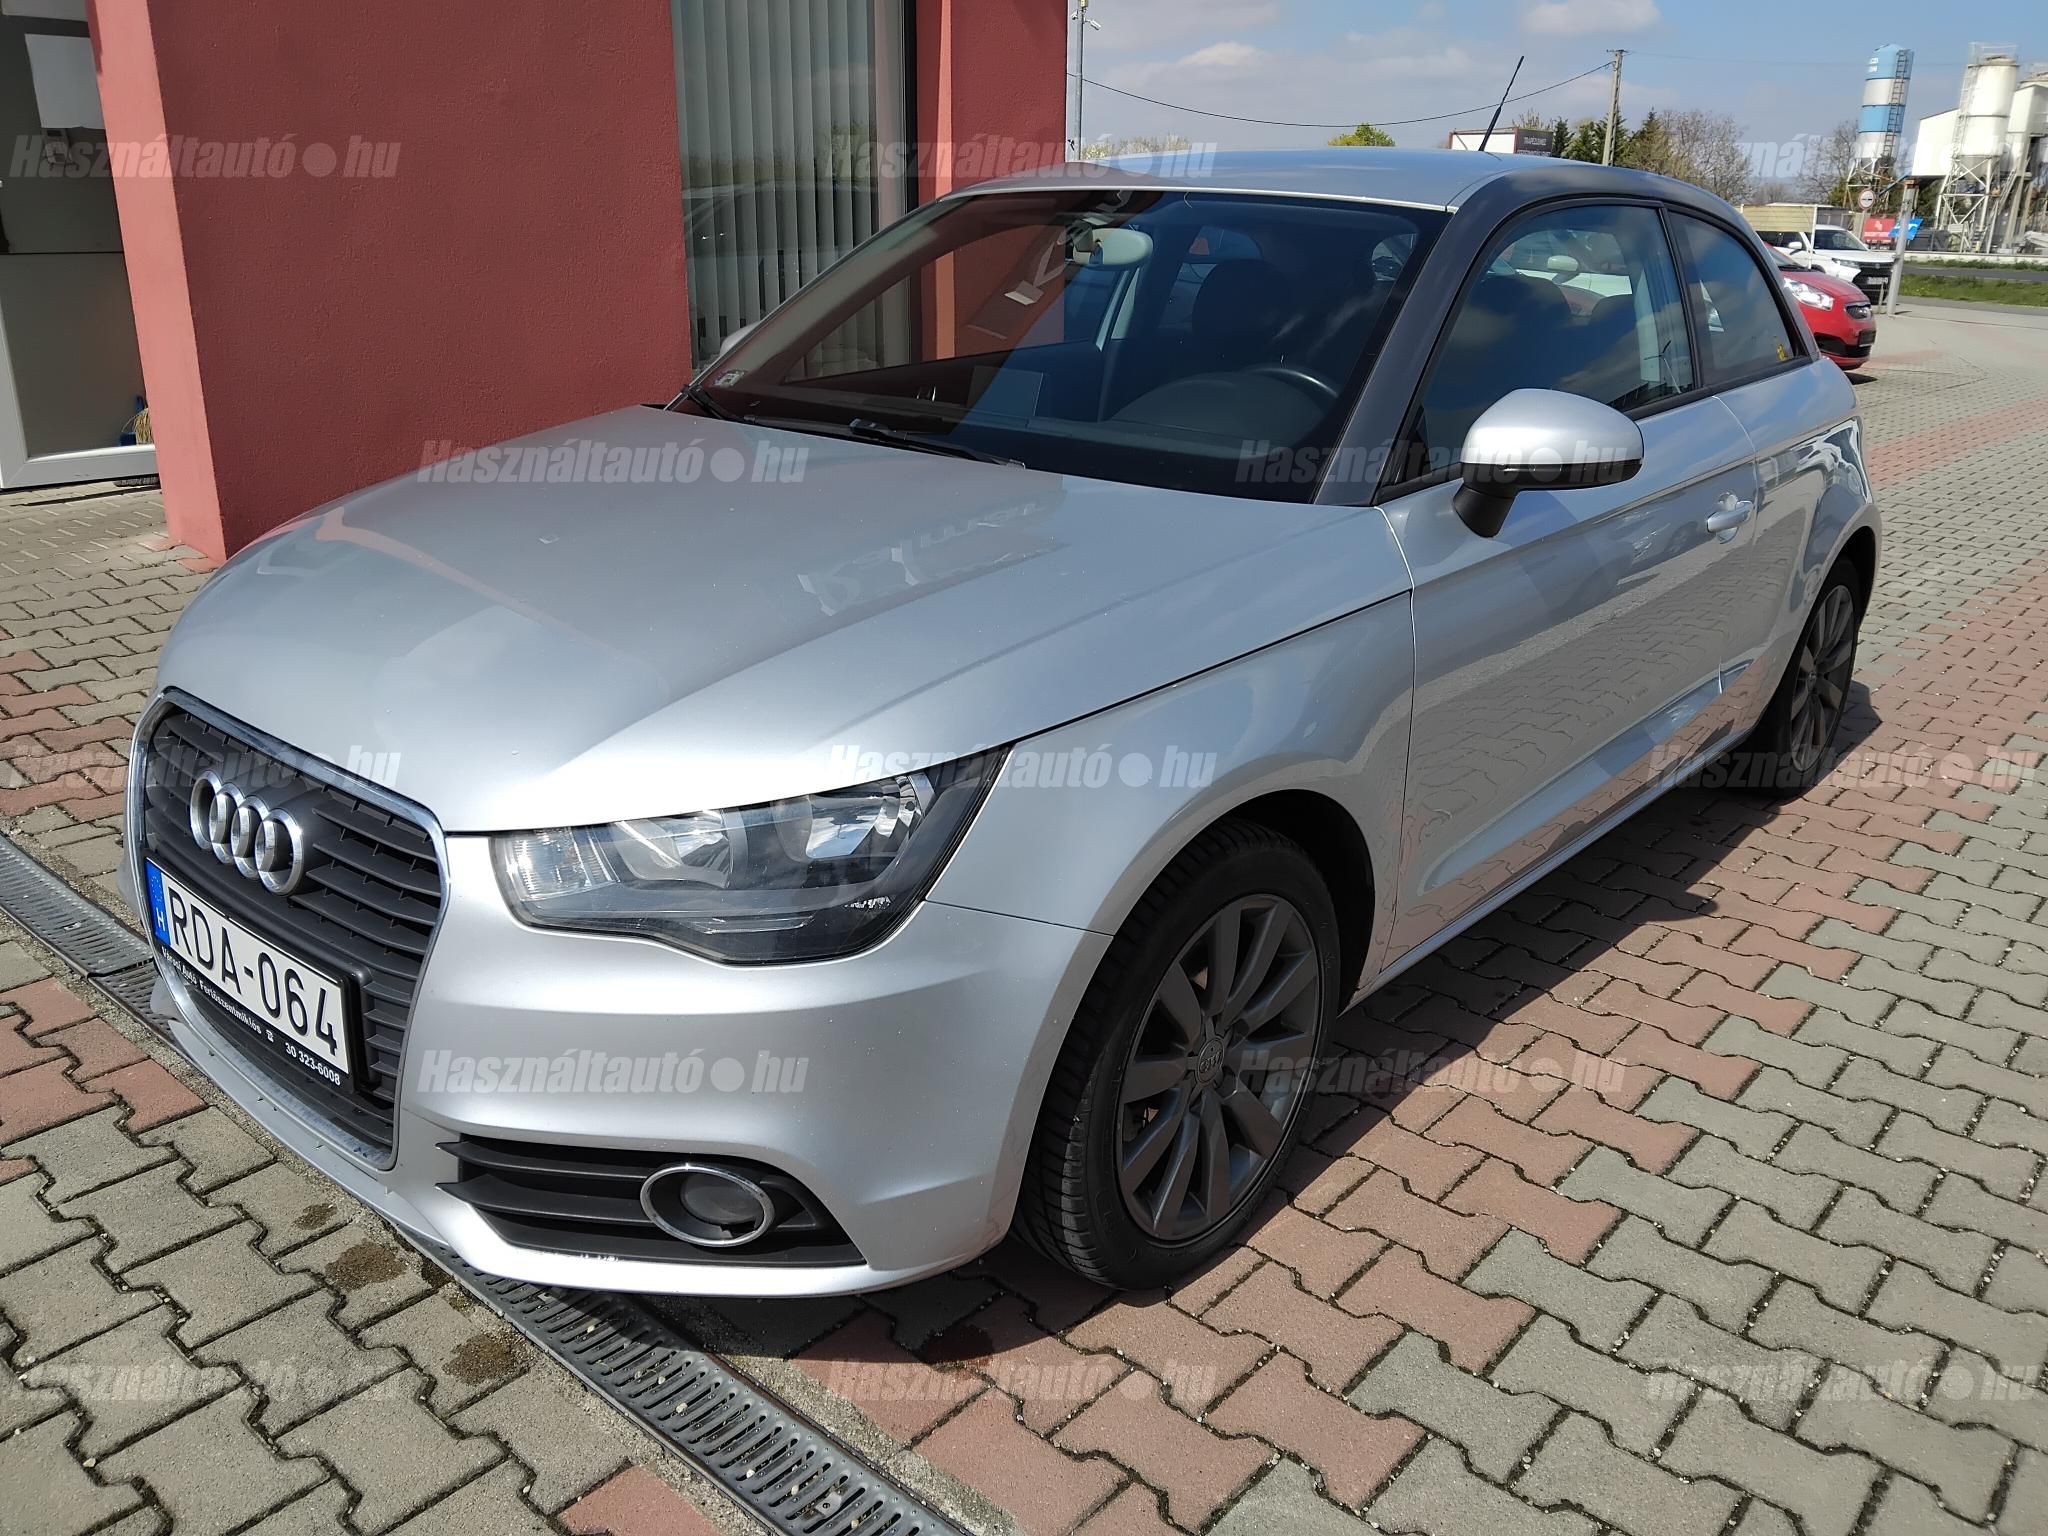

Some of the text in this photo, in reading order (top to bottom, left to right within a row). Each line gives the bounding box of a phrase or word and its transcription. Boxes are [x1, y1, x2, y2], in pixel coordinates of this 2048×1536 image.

[156, 907, 165, 932] H
[168, 886, 338, 1056] RDA-064
[285, 1042, 297, 1057] 30
[299, 1050, 341, 1086] 323-6008
